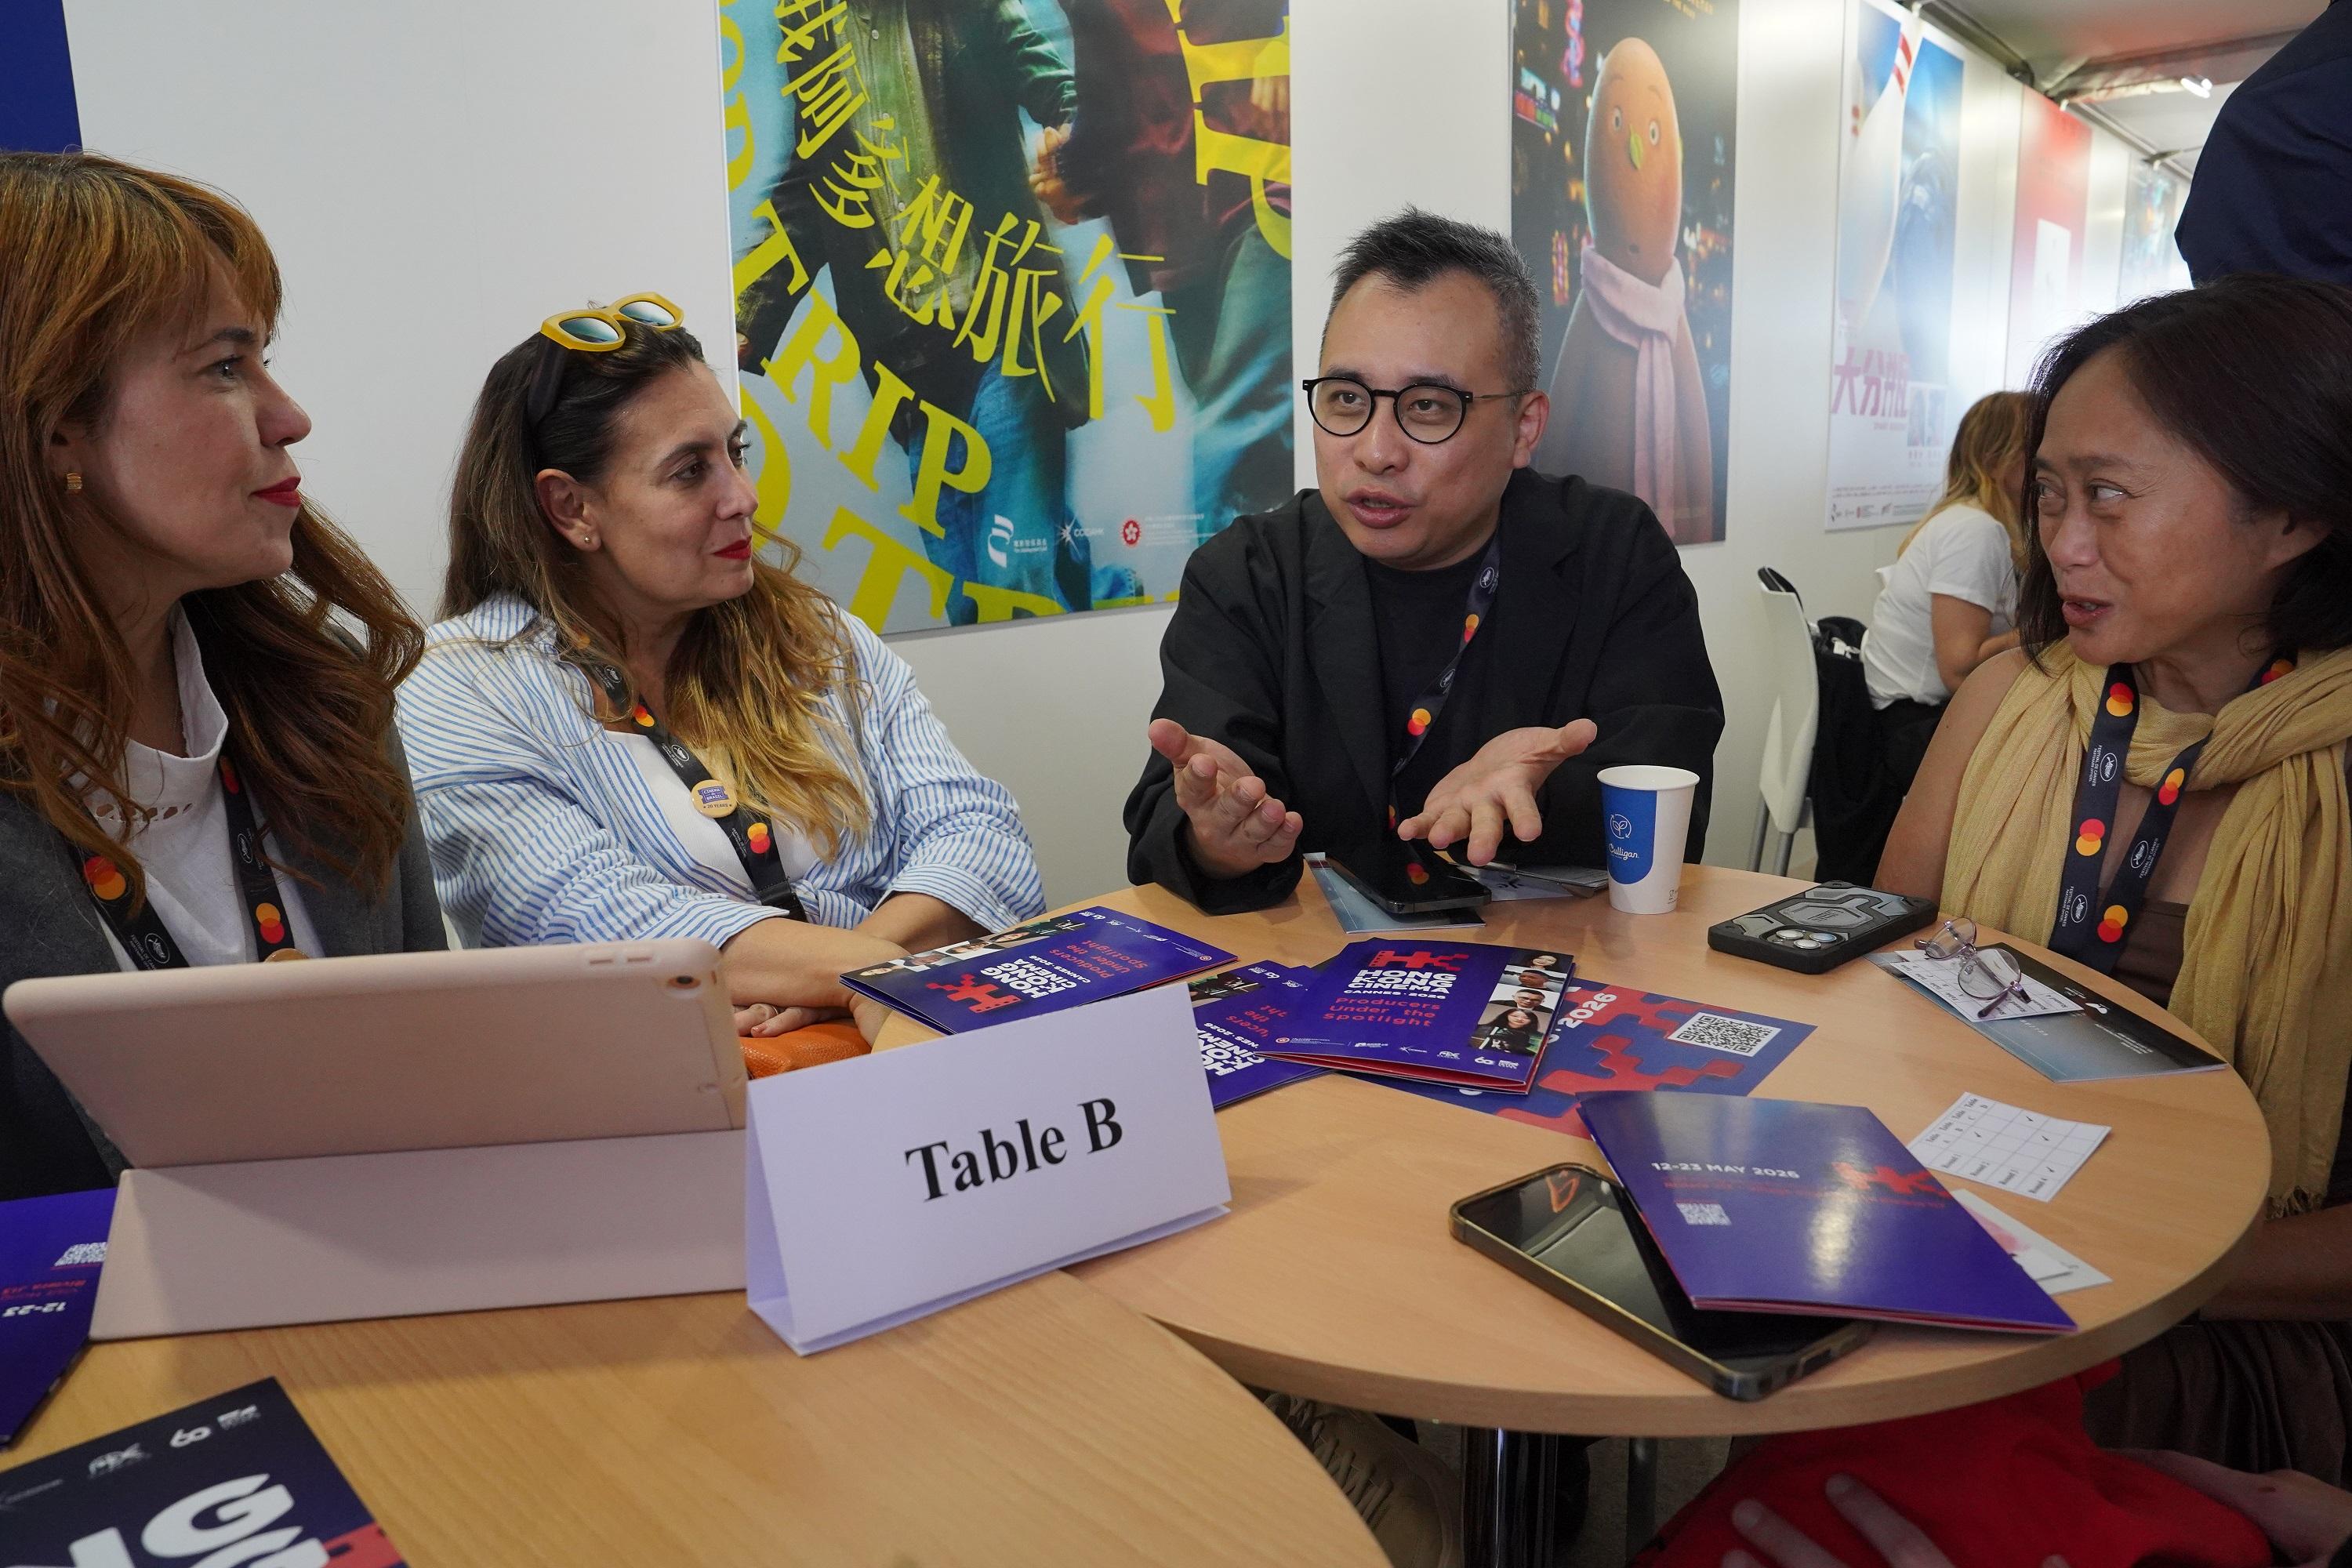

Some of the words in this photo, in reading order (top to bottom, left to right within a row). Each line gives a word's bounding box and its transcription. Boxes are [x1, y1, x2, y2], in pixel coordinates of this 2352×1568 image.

[732, 199, 993, 539] TRIP
[1609, 843, 1638, 861] Culligan
[980, 967, 1051, 999] HONG
[996, 962, 1066, 996] KONG
[1013, 957, 1077, 989] CINEMA
[1351, 976, 1454, 988] KONG
[1357, 969, 1457, 981] HONG
[1347, 982, 1450, 995] CINEMA
[1323, 1013, 1432, 1027] Spotlight
[1329, 1004, 1390, 1014] Under
[1403, 1008, 1436, 1018] the
[1557, 993, 1617, 1029] 2026
[1225, 1015, 1269, 1038] ucers
[1199, 1039, 1254, 1069] KON
[904, 1118, 1067, 1202] Table
[1077, 1098, 1123, 1154] B
[1650, 1162, 1702, 1171] 12-23
[1706, 1163, 1745, 1174] MAY
[1751, 1167, 1800, 1179] 2026
[2, 1301, 67, 1317] 12-23
